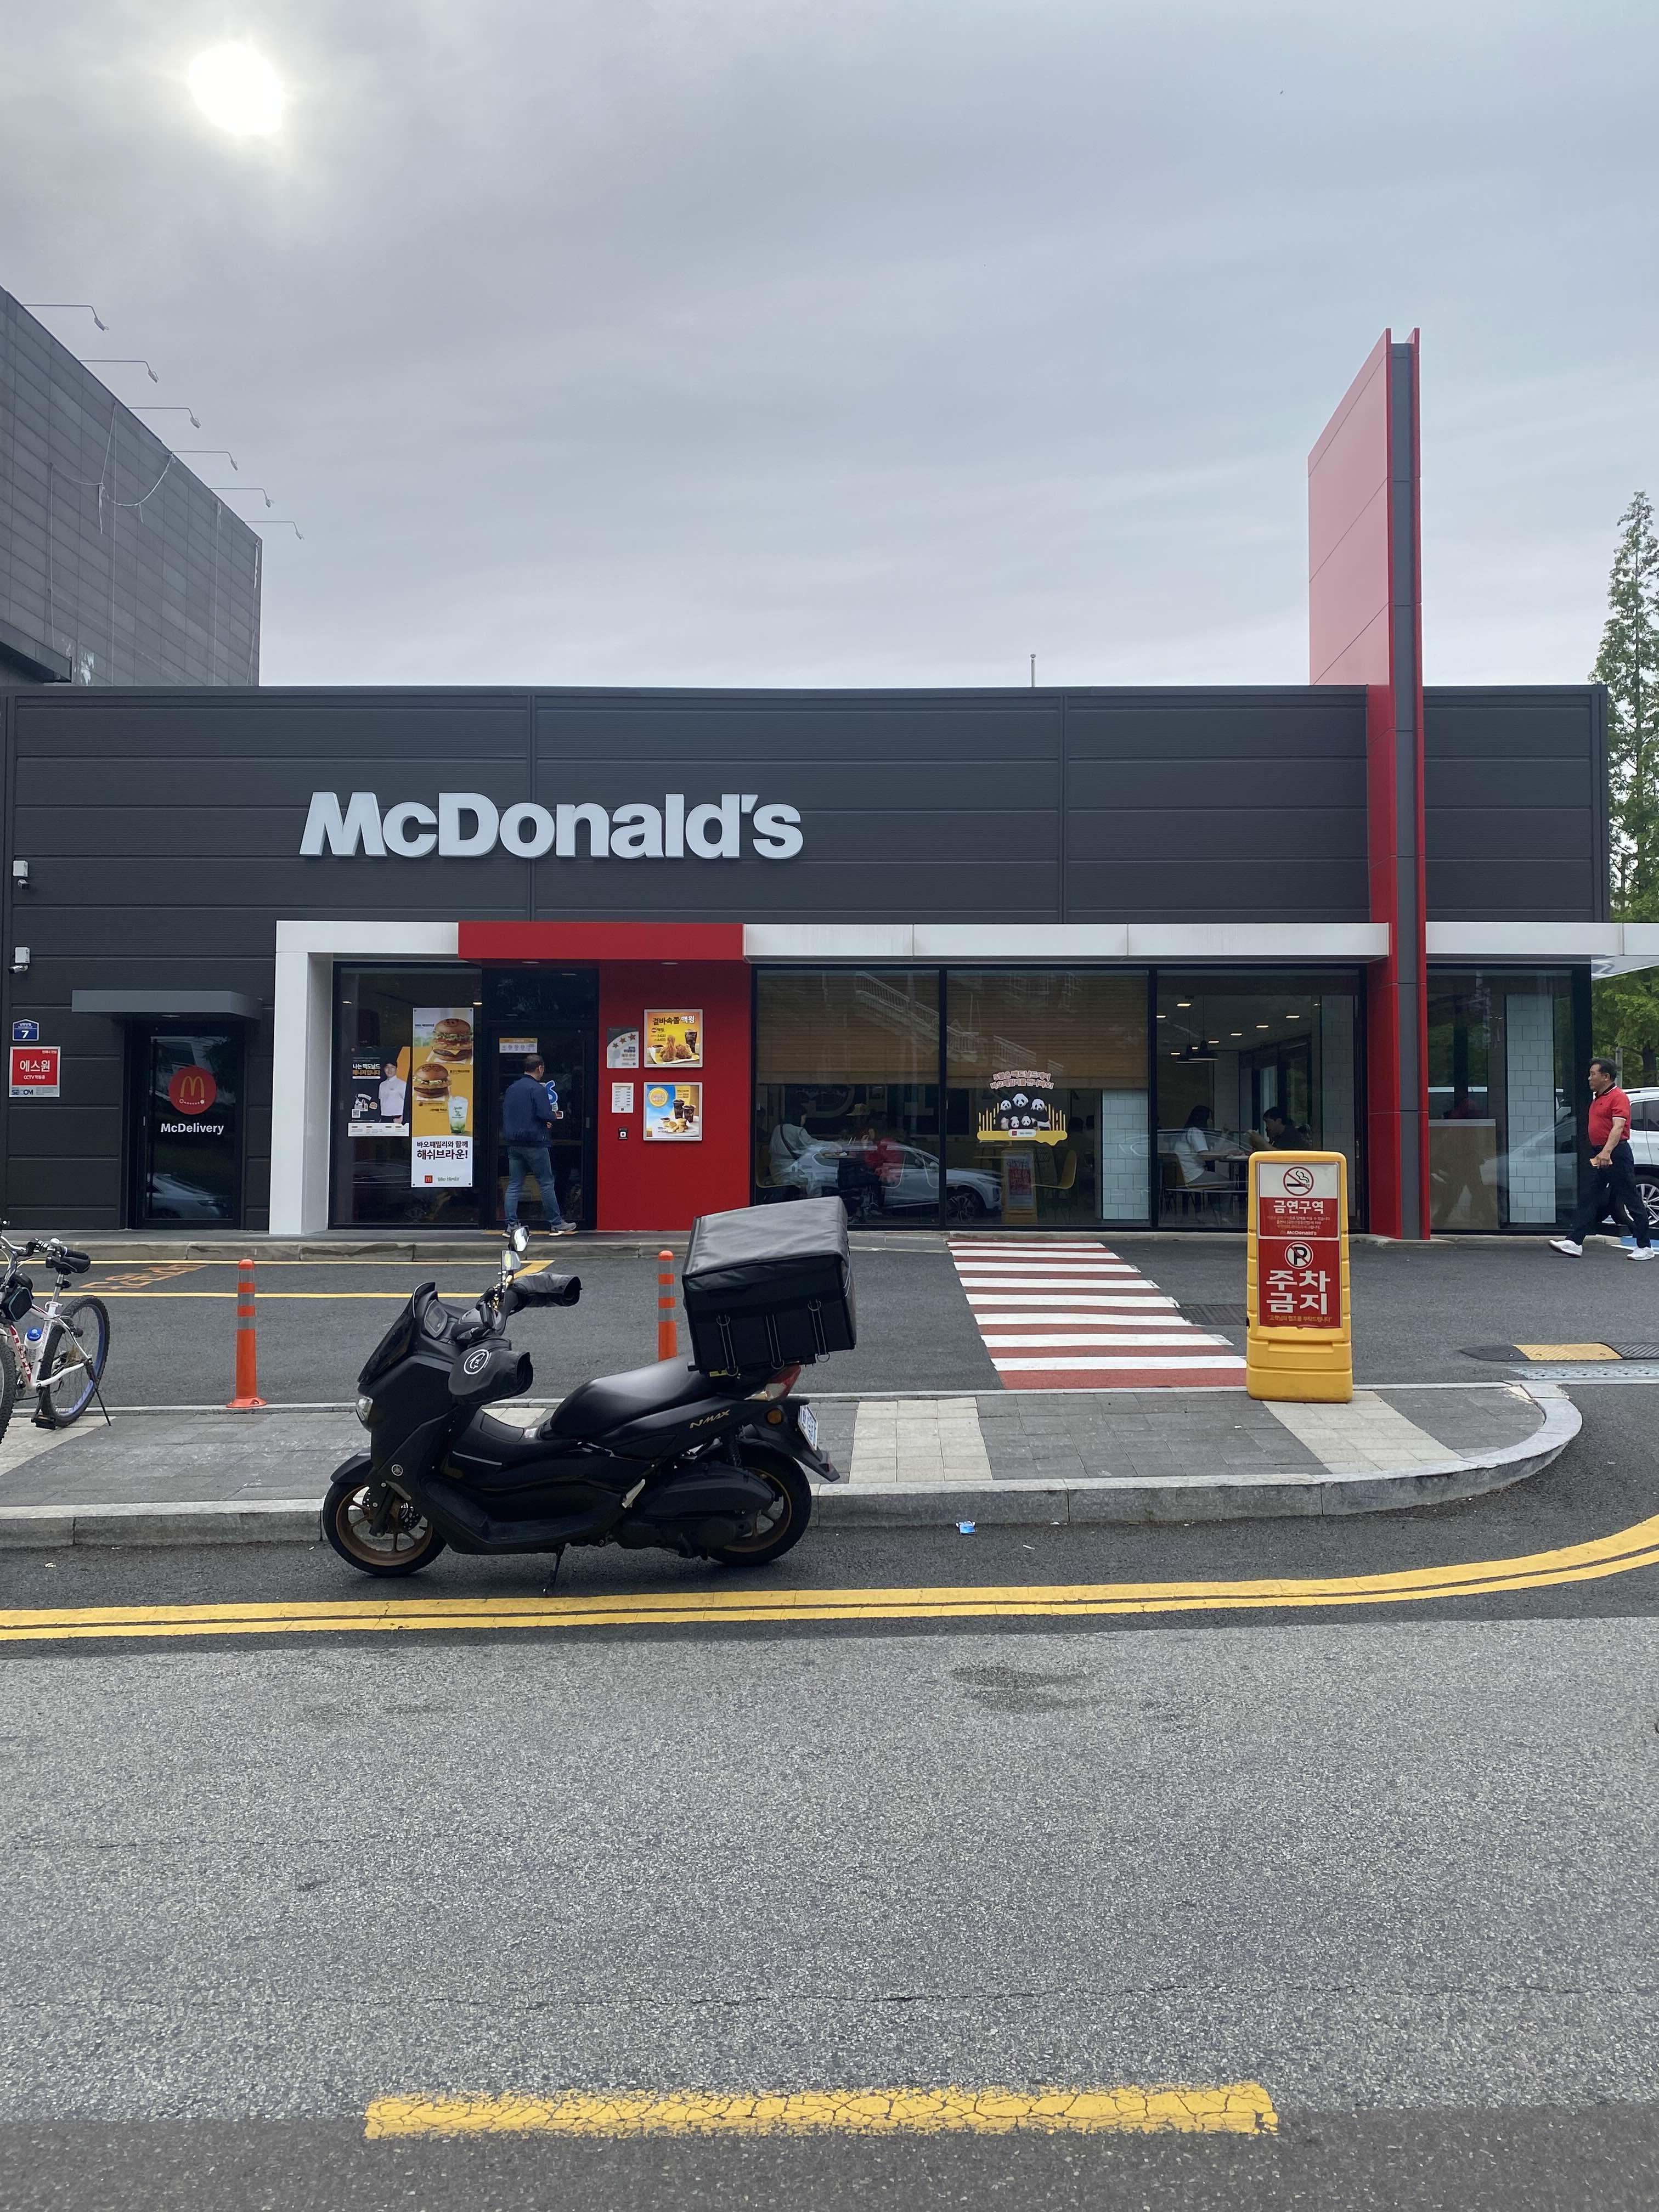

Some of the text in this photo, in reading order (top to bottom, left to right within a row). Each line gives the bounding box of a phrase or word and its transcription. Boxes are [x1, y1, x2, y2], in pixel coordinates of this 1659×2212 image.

[299, 791, 804, 860] McDonald's
[21, 1030, 29, 1039] 7
[20, 1060, 50, 1072] 에스원
[160, 1122, 224, 1135] McDelivery
[417, 1149, 468, 1160] 해쉬브라운!
[1273, 1200, 1324, 1214] 금연구역
[1266, 1270, 1331, 1293] 주차
[1266, 1292, 1327, 1314] 금지
[689, 1409, 731, 1429] NMAX
